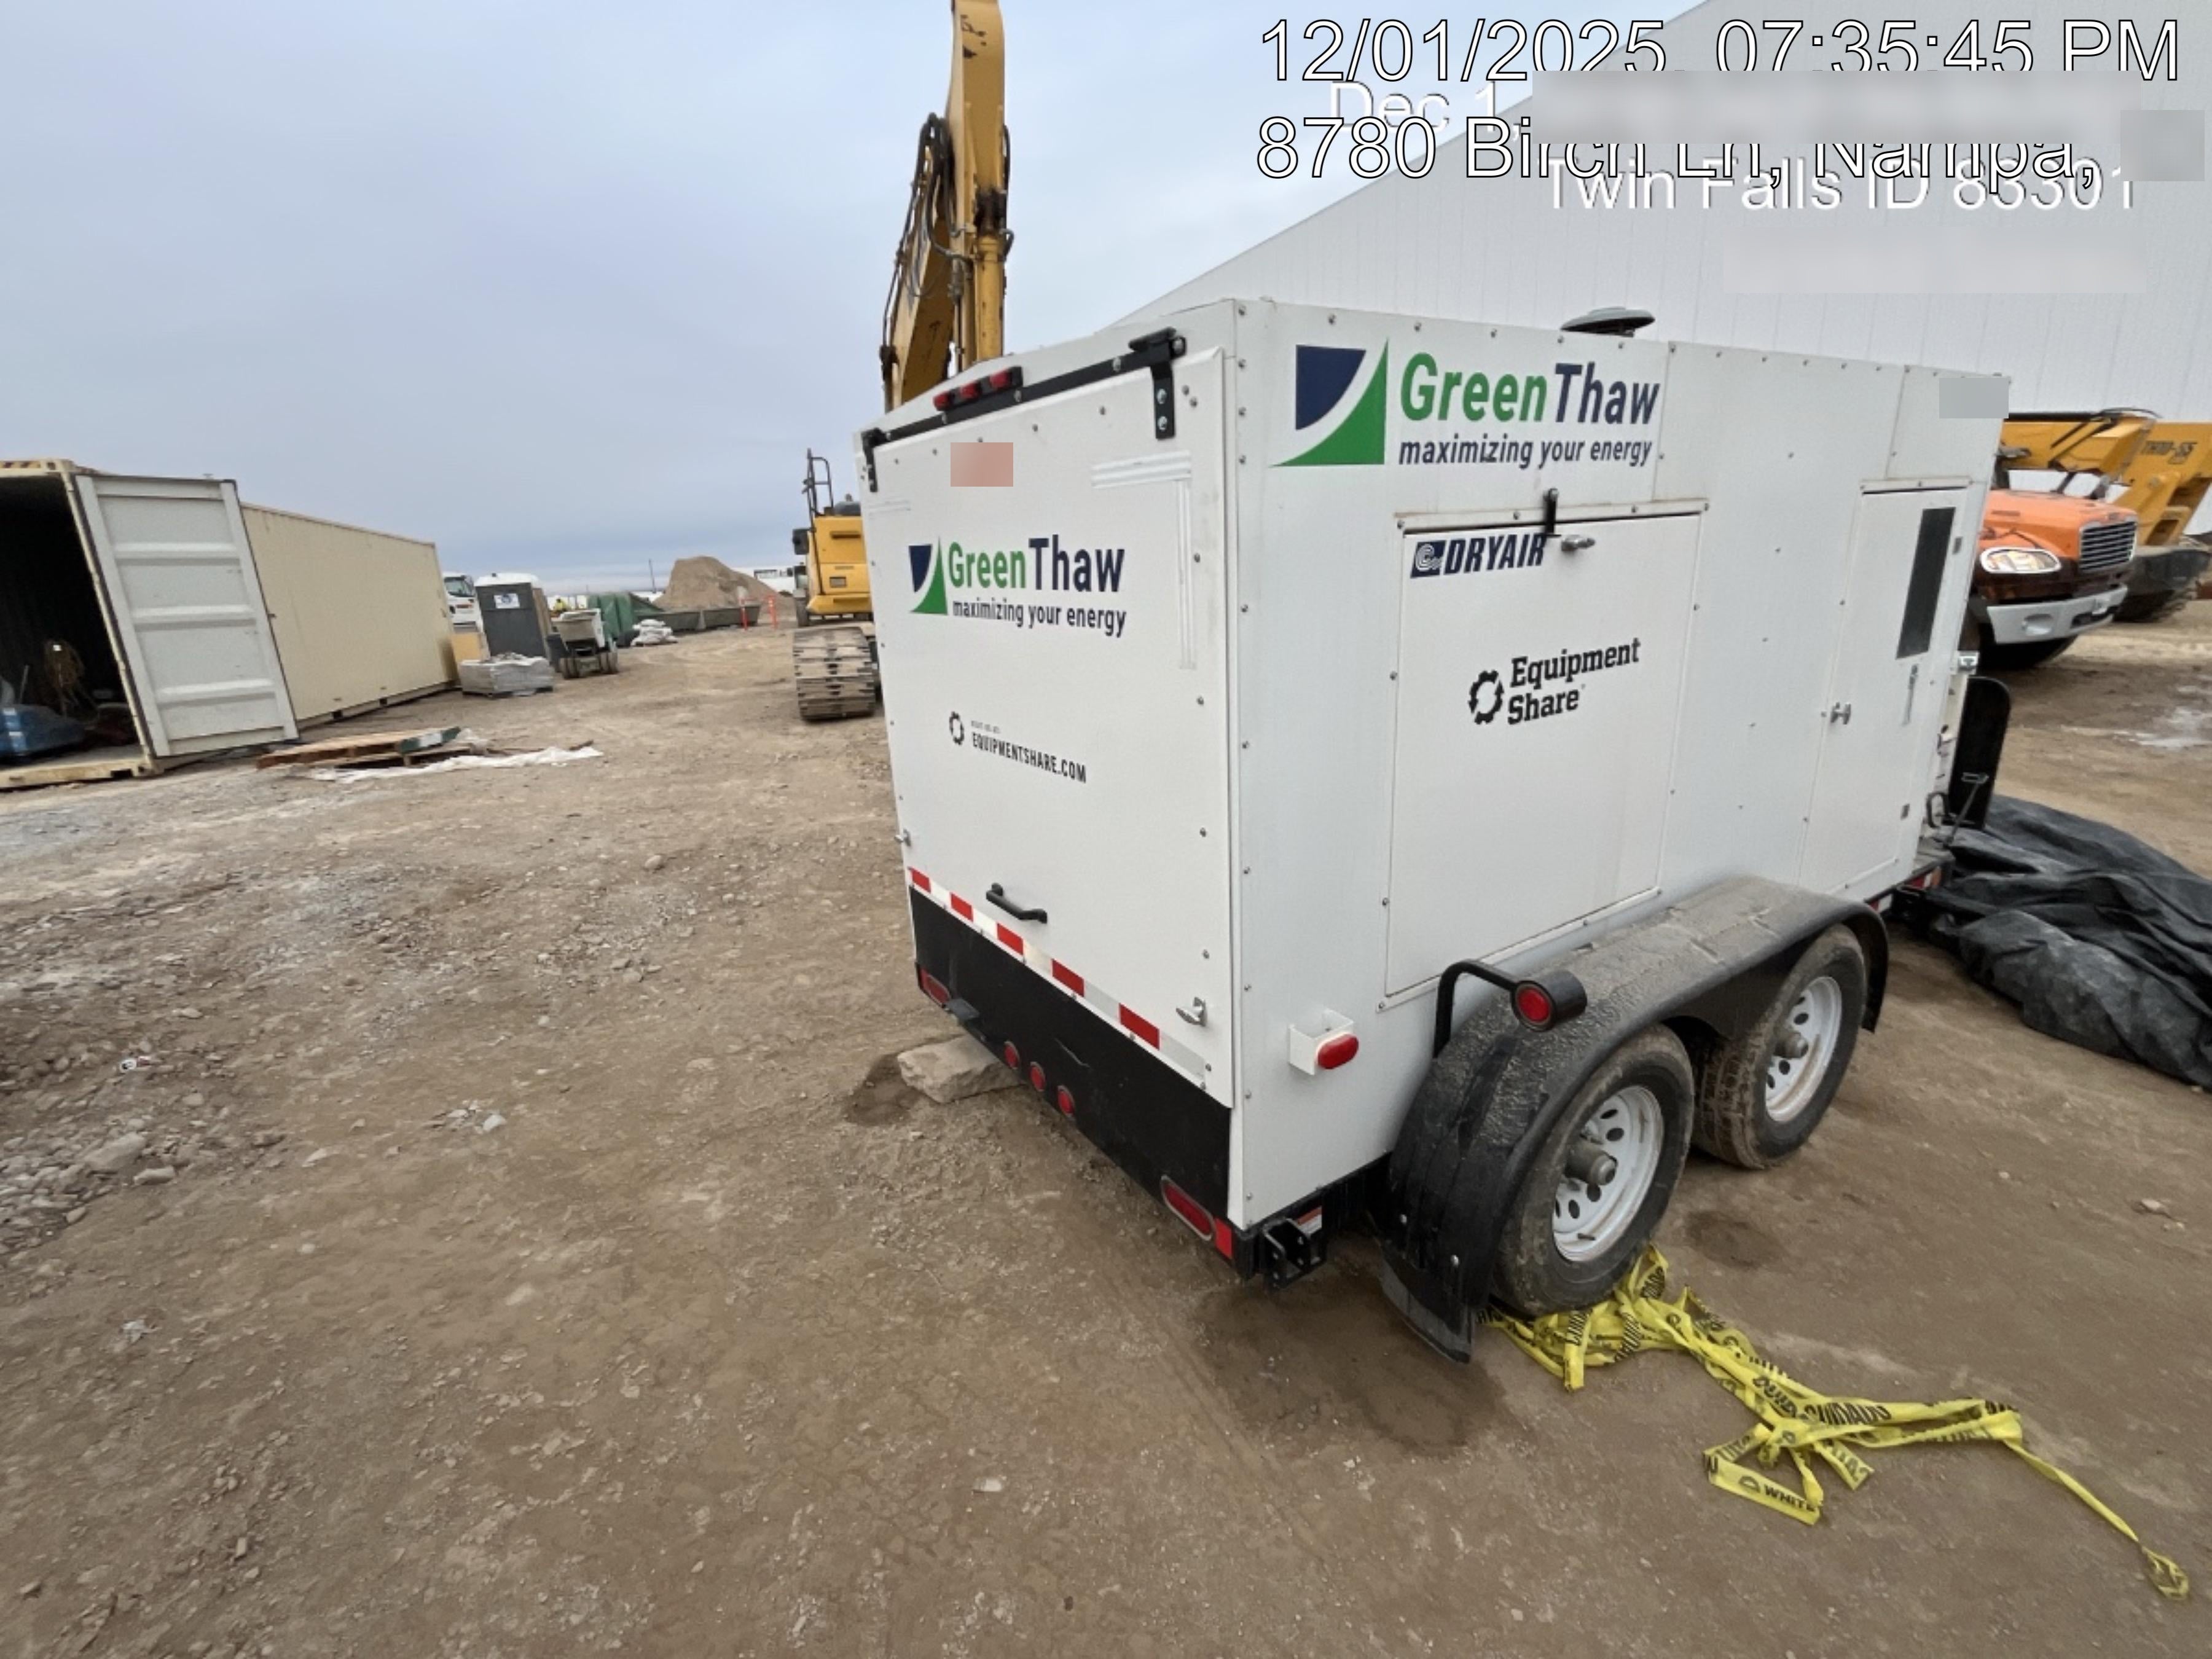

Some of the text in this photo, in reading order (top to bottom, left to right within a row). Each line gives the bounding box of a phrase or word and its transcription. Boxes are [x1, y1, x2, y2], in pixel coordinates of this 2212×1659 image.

[1398, 433, 1653, 470] maximizing your energy
[1443, 533, 1548, 576] DRYAIR
[952, 597, 1128, 638] maximizing your energy
[1509, 637, 1641, 690] Equipment
[1507, 689, 1580, 725] Share
[972, 732, 1087, 783] EQUIPMENTSHARE.COM
